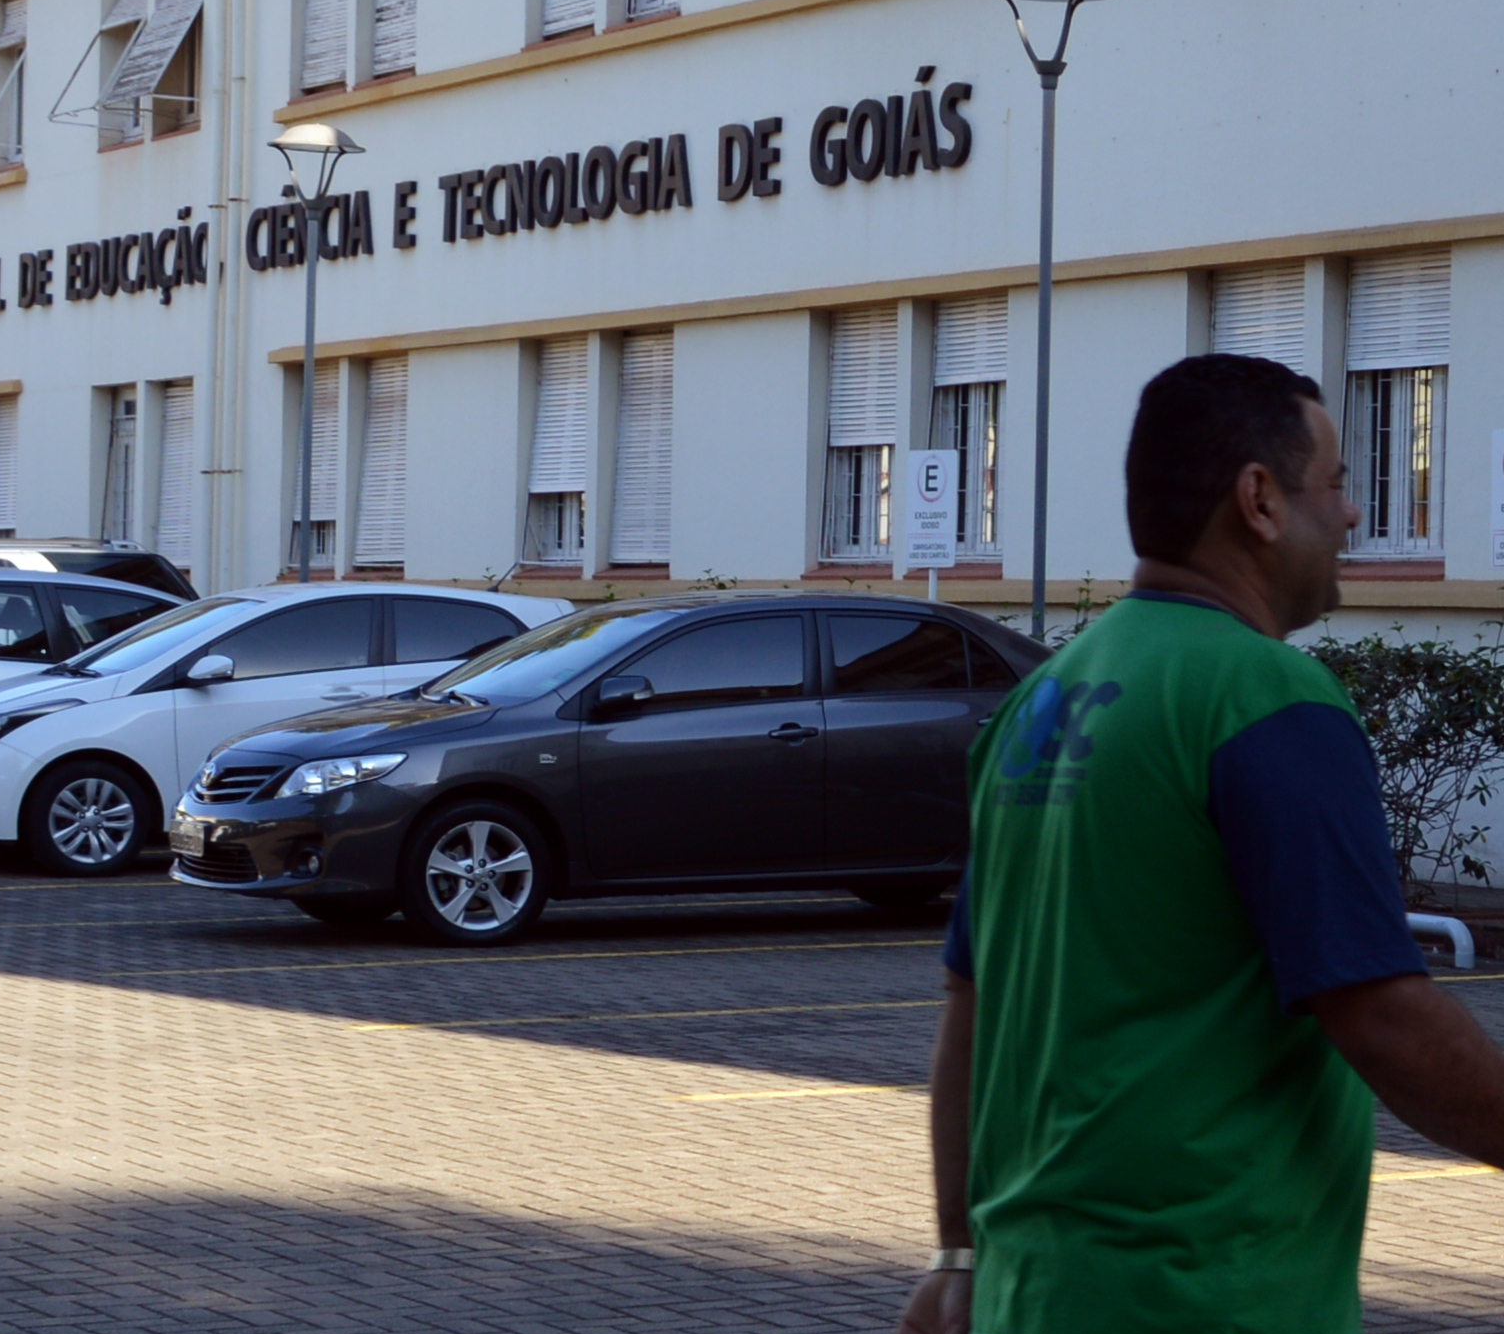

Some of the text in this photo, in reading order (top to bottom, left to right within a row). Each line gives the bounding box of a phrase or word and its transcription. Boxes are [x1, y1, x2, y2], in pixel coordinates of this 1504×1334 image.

[17, 248, 55, 309] DE
[246, 184, 374, 272] CIÊNCIA
[392, 179, 418, 250] E
[439, 132, 693, 244] TECNOLOGIA
[717, 115, 783, 204] DE
[809, 64, 973, 187] GOIÁS
[924, 464, 939, 492] E
